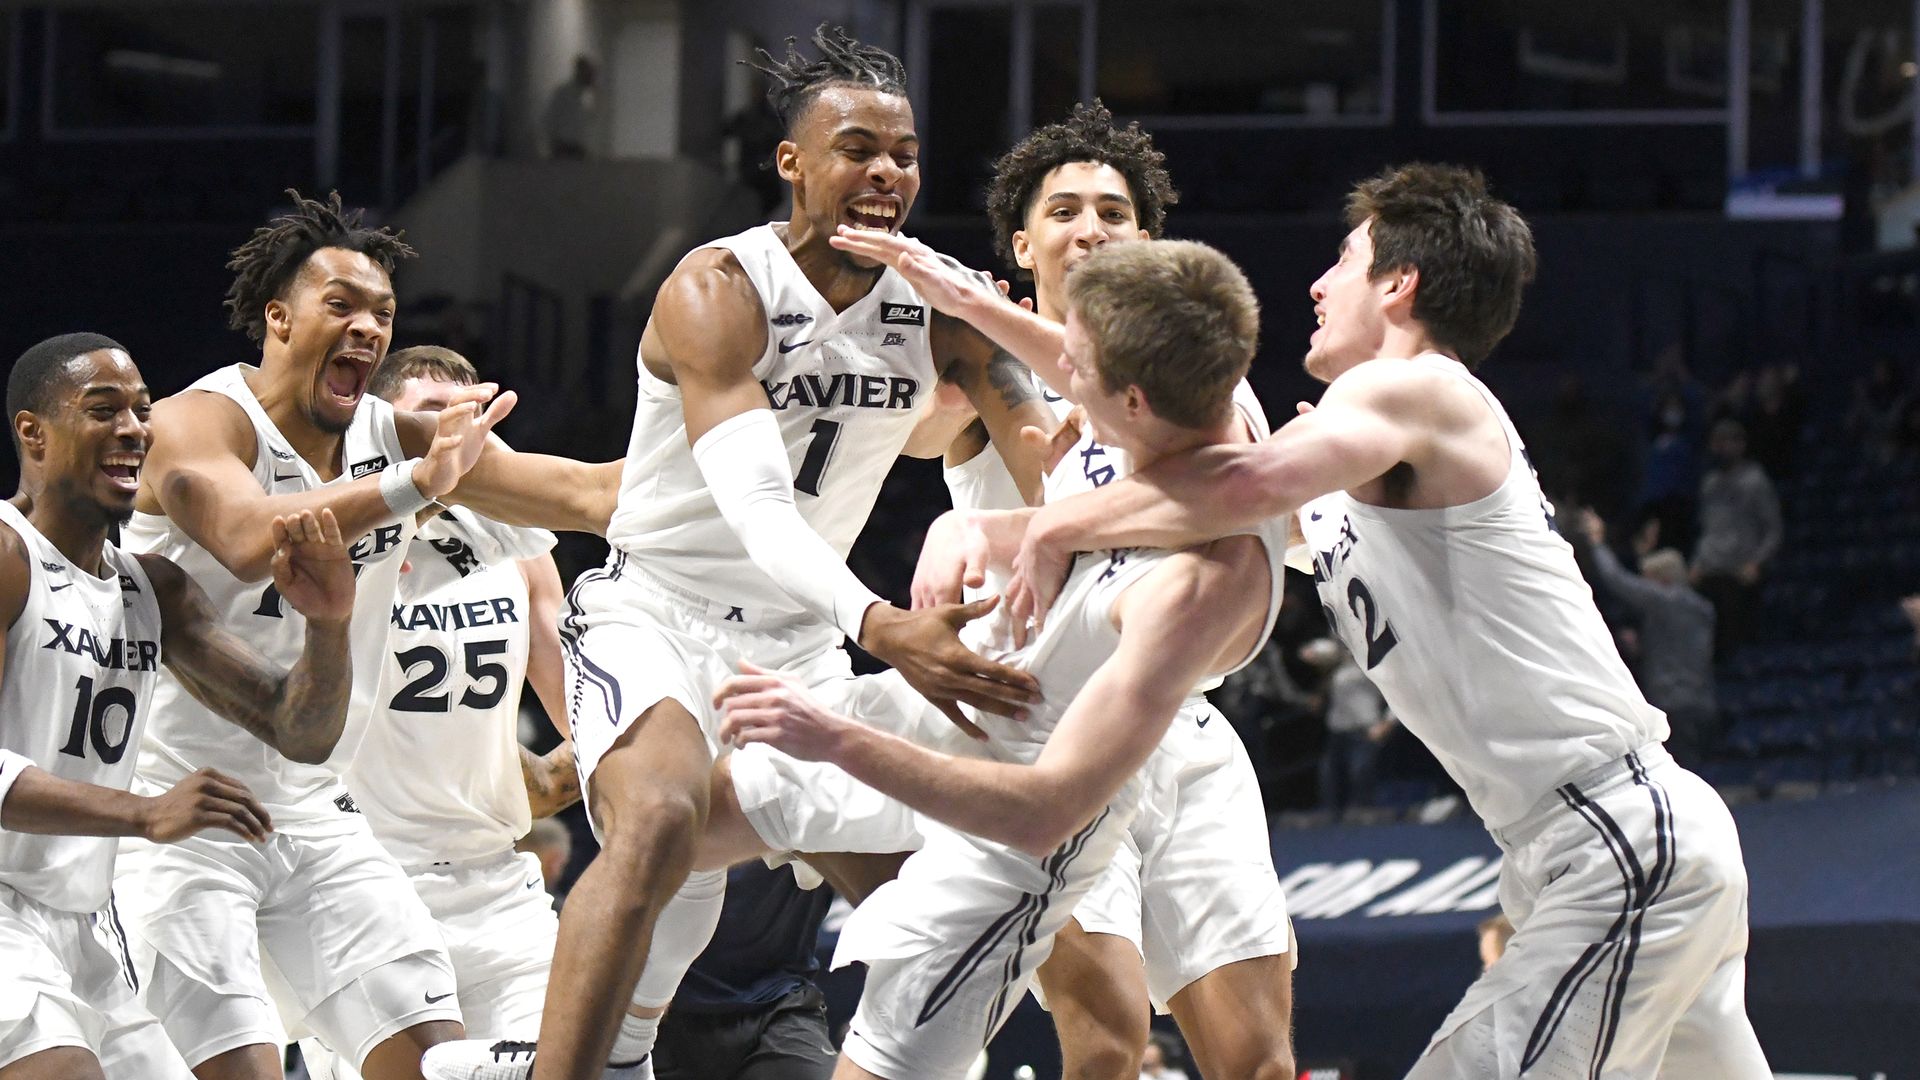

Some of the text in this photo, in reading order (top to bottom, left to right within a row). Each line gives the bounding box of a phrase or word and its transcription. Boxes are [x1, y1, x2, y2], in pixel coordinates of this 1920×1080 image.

[887, 306, 920, 319] BLM
[760, 374, 919, 410] XAVIER
[353, 459, 384, 476] BLM
[793, 418, 843, 496] 1
[391, 597, 519, 632] XAVIER
[42, 618, 158, 671] XAVIER
[389, 639, 510, 713] 25
[59, 675, 136, 764] 10
